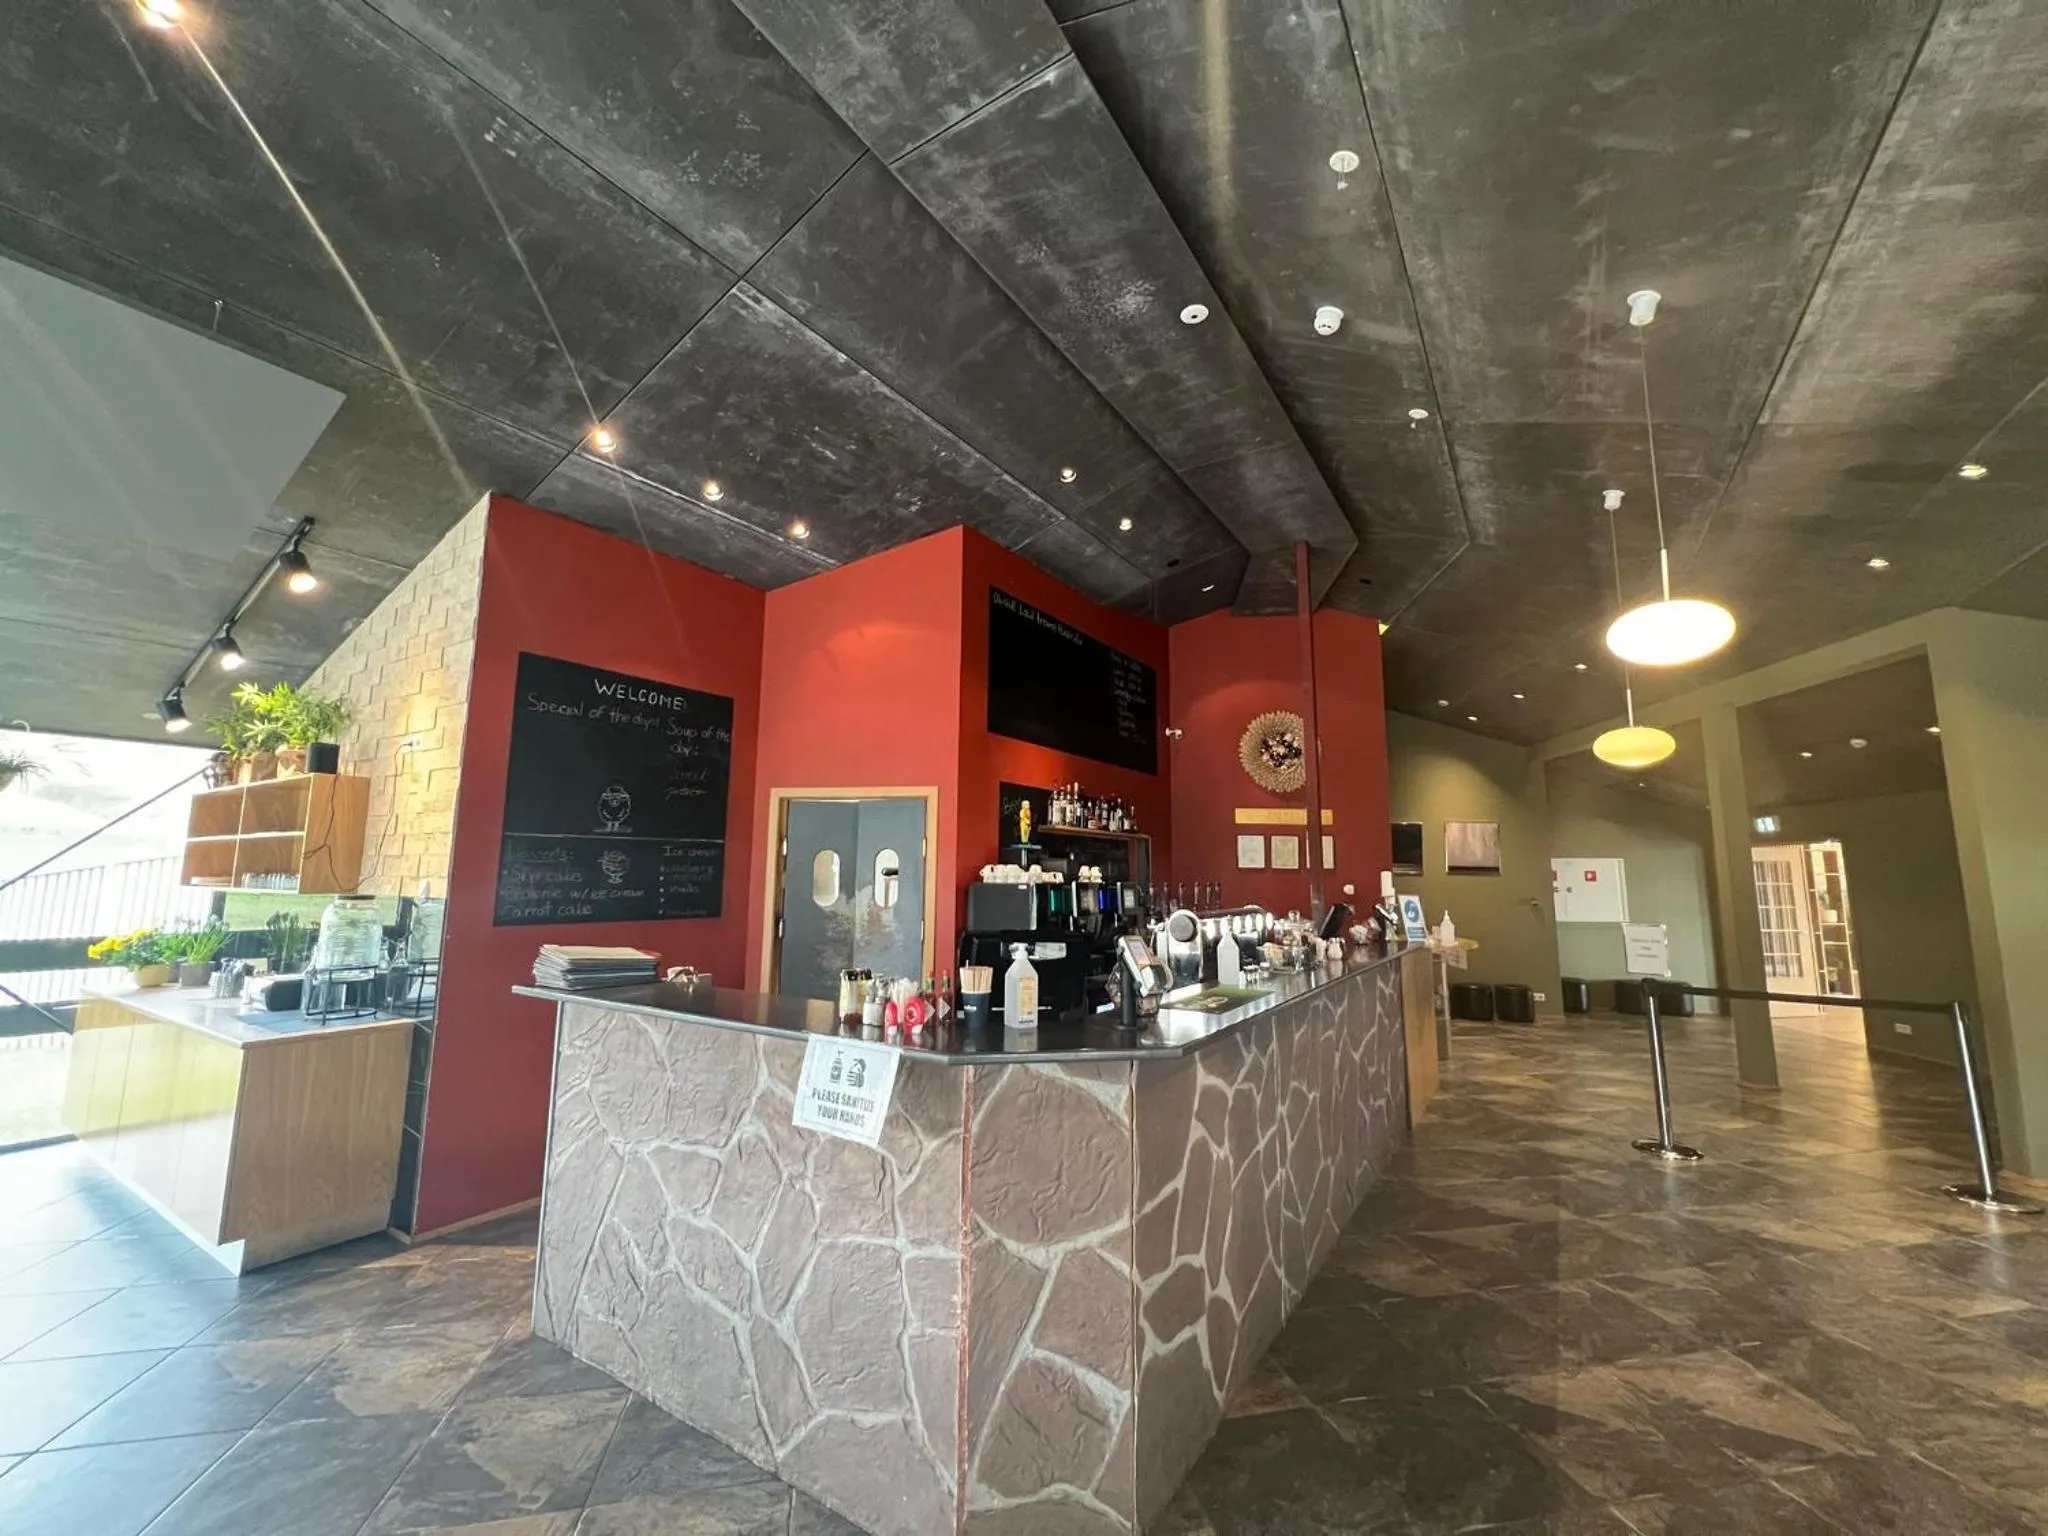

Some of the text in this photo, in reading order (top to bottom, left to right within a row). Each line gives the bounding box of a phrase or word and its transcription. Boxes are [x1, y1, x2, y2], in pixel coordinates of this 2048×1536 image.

[588, 704, 607, 719] of
[609, 706, 631, 724] the
[666, 717, 698, 741] Soup
[701, 725, 714, 738] of
[811, 1087, 841, 1104] PLEASE
[817, 1104, 839, 1121] YOUR
